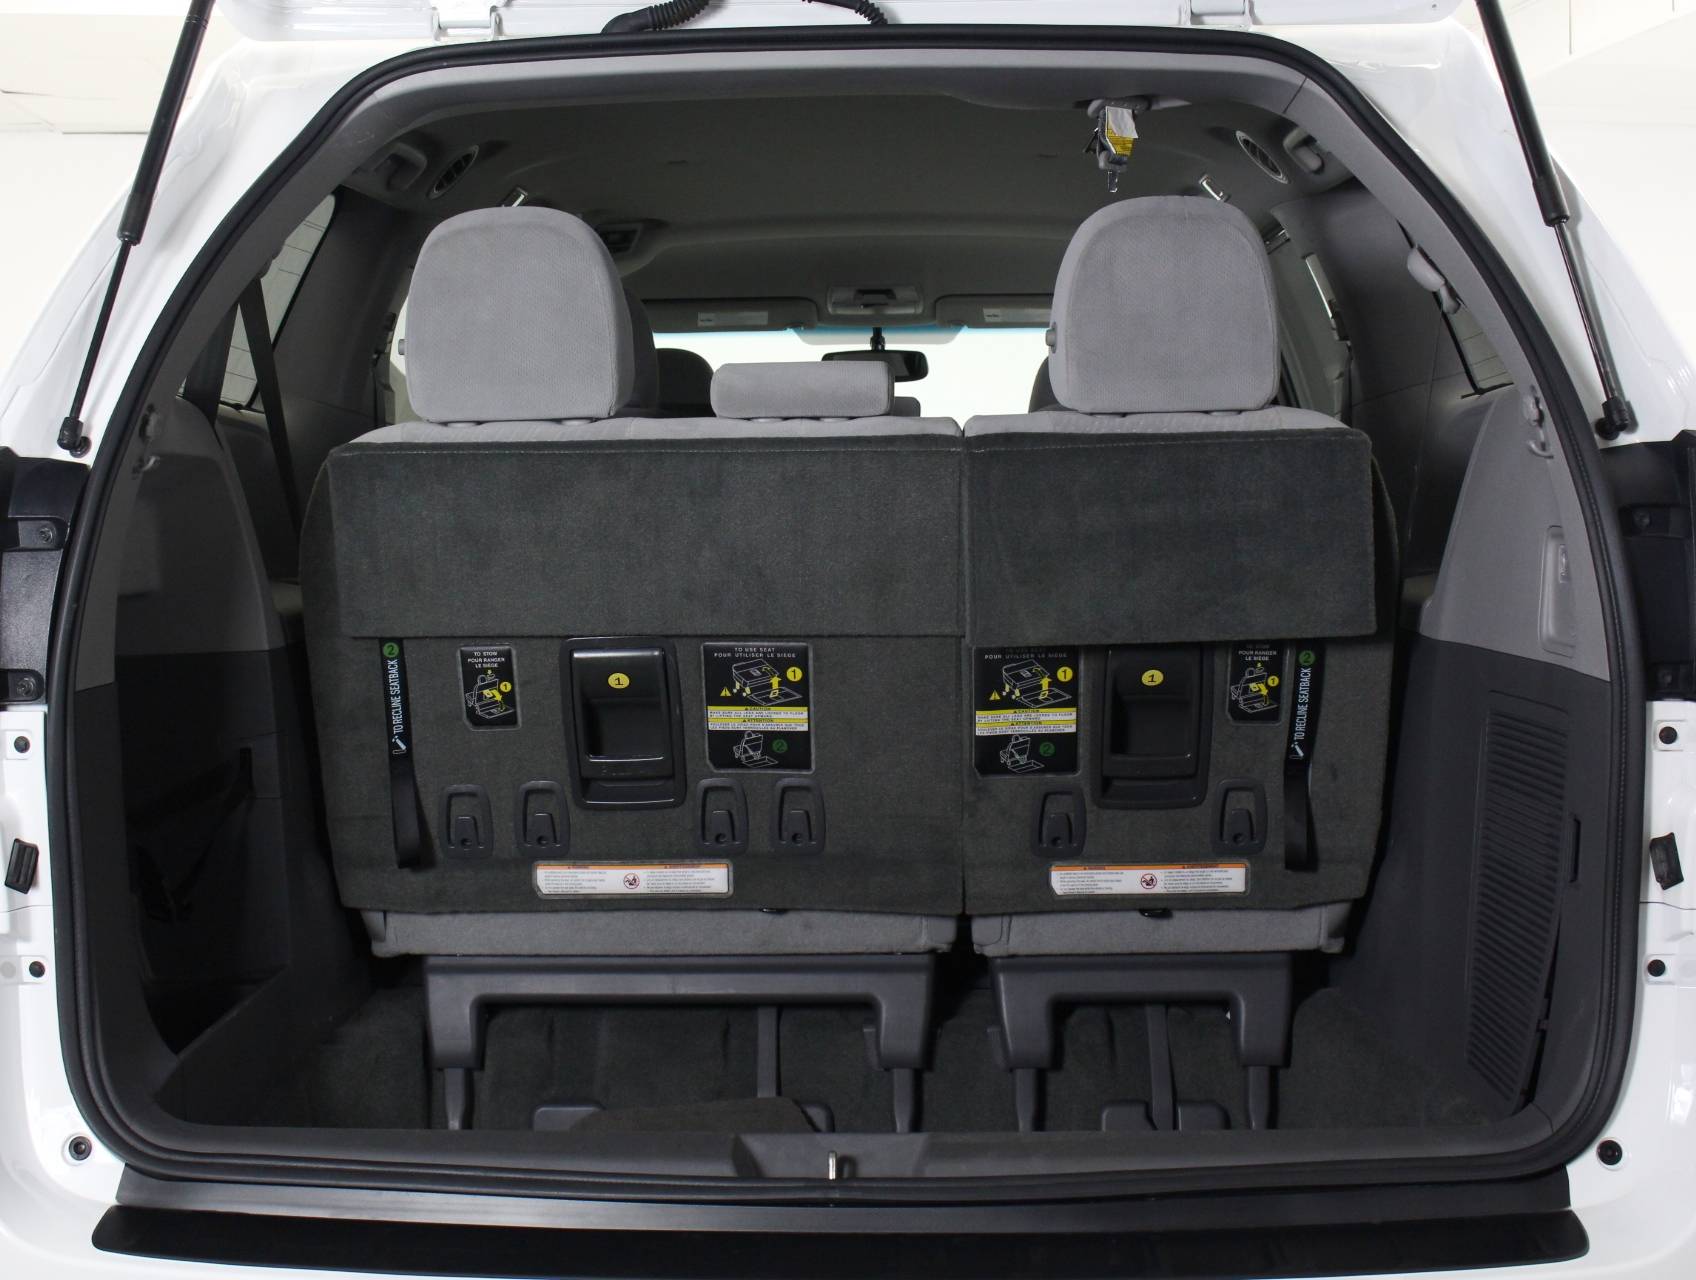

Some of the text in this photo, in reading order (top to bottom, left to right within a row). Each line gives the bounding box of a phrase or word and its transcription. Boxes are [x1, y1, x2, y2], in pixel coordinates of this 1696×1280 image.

[387, 659, 404, 735] TO RECLINE SEATBACK
[614, 677, 624, 685] 1
[1147, 674, 1157, 682] 1
[1294, 667, 1312, 740] TO RECLINE SEATBACK
